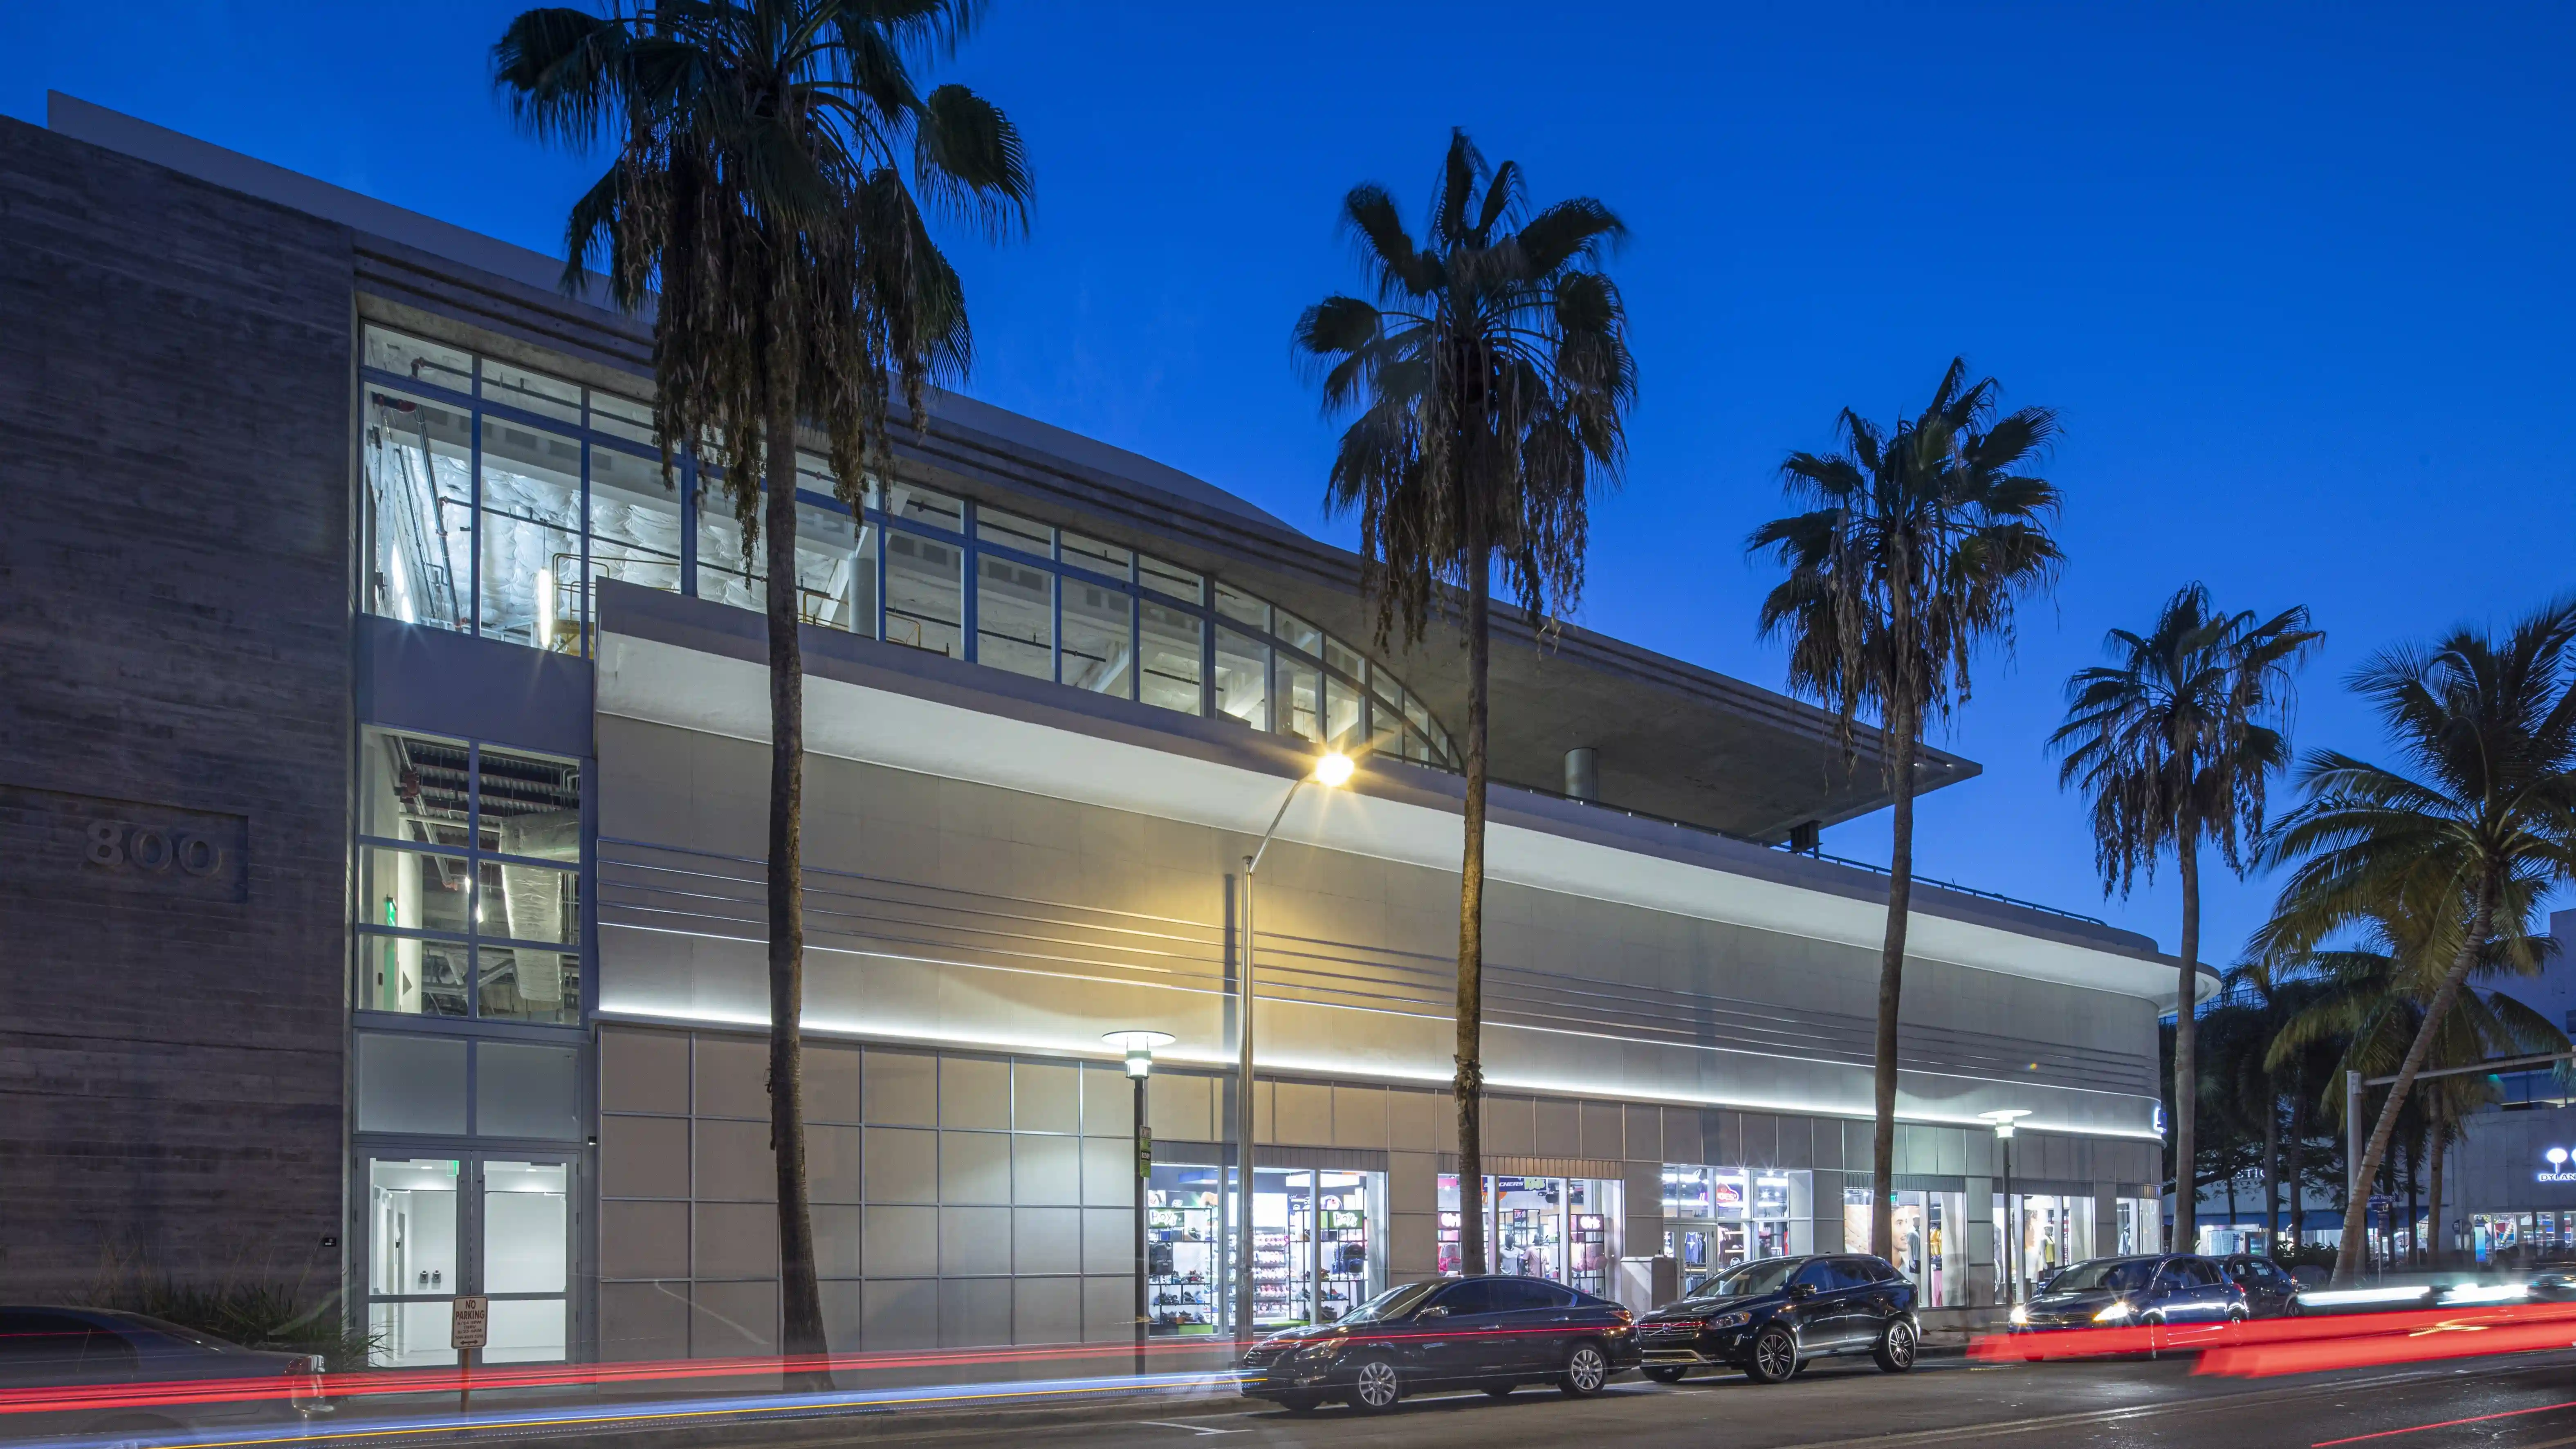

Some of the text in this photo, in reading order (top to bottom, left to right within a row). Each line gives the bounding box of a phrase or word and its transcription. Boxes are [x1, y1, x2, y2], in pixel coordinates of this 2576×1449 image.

[86, 819, 222, 877] 800
[465, 1300, 476, 1309] NO
[456, 1310, 485, 1320] PARKING
